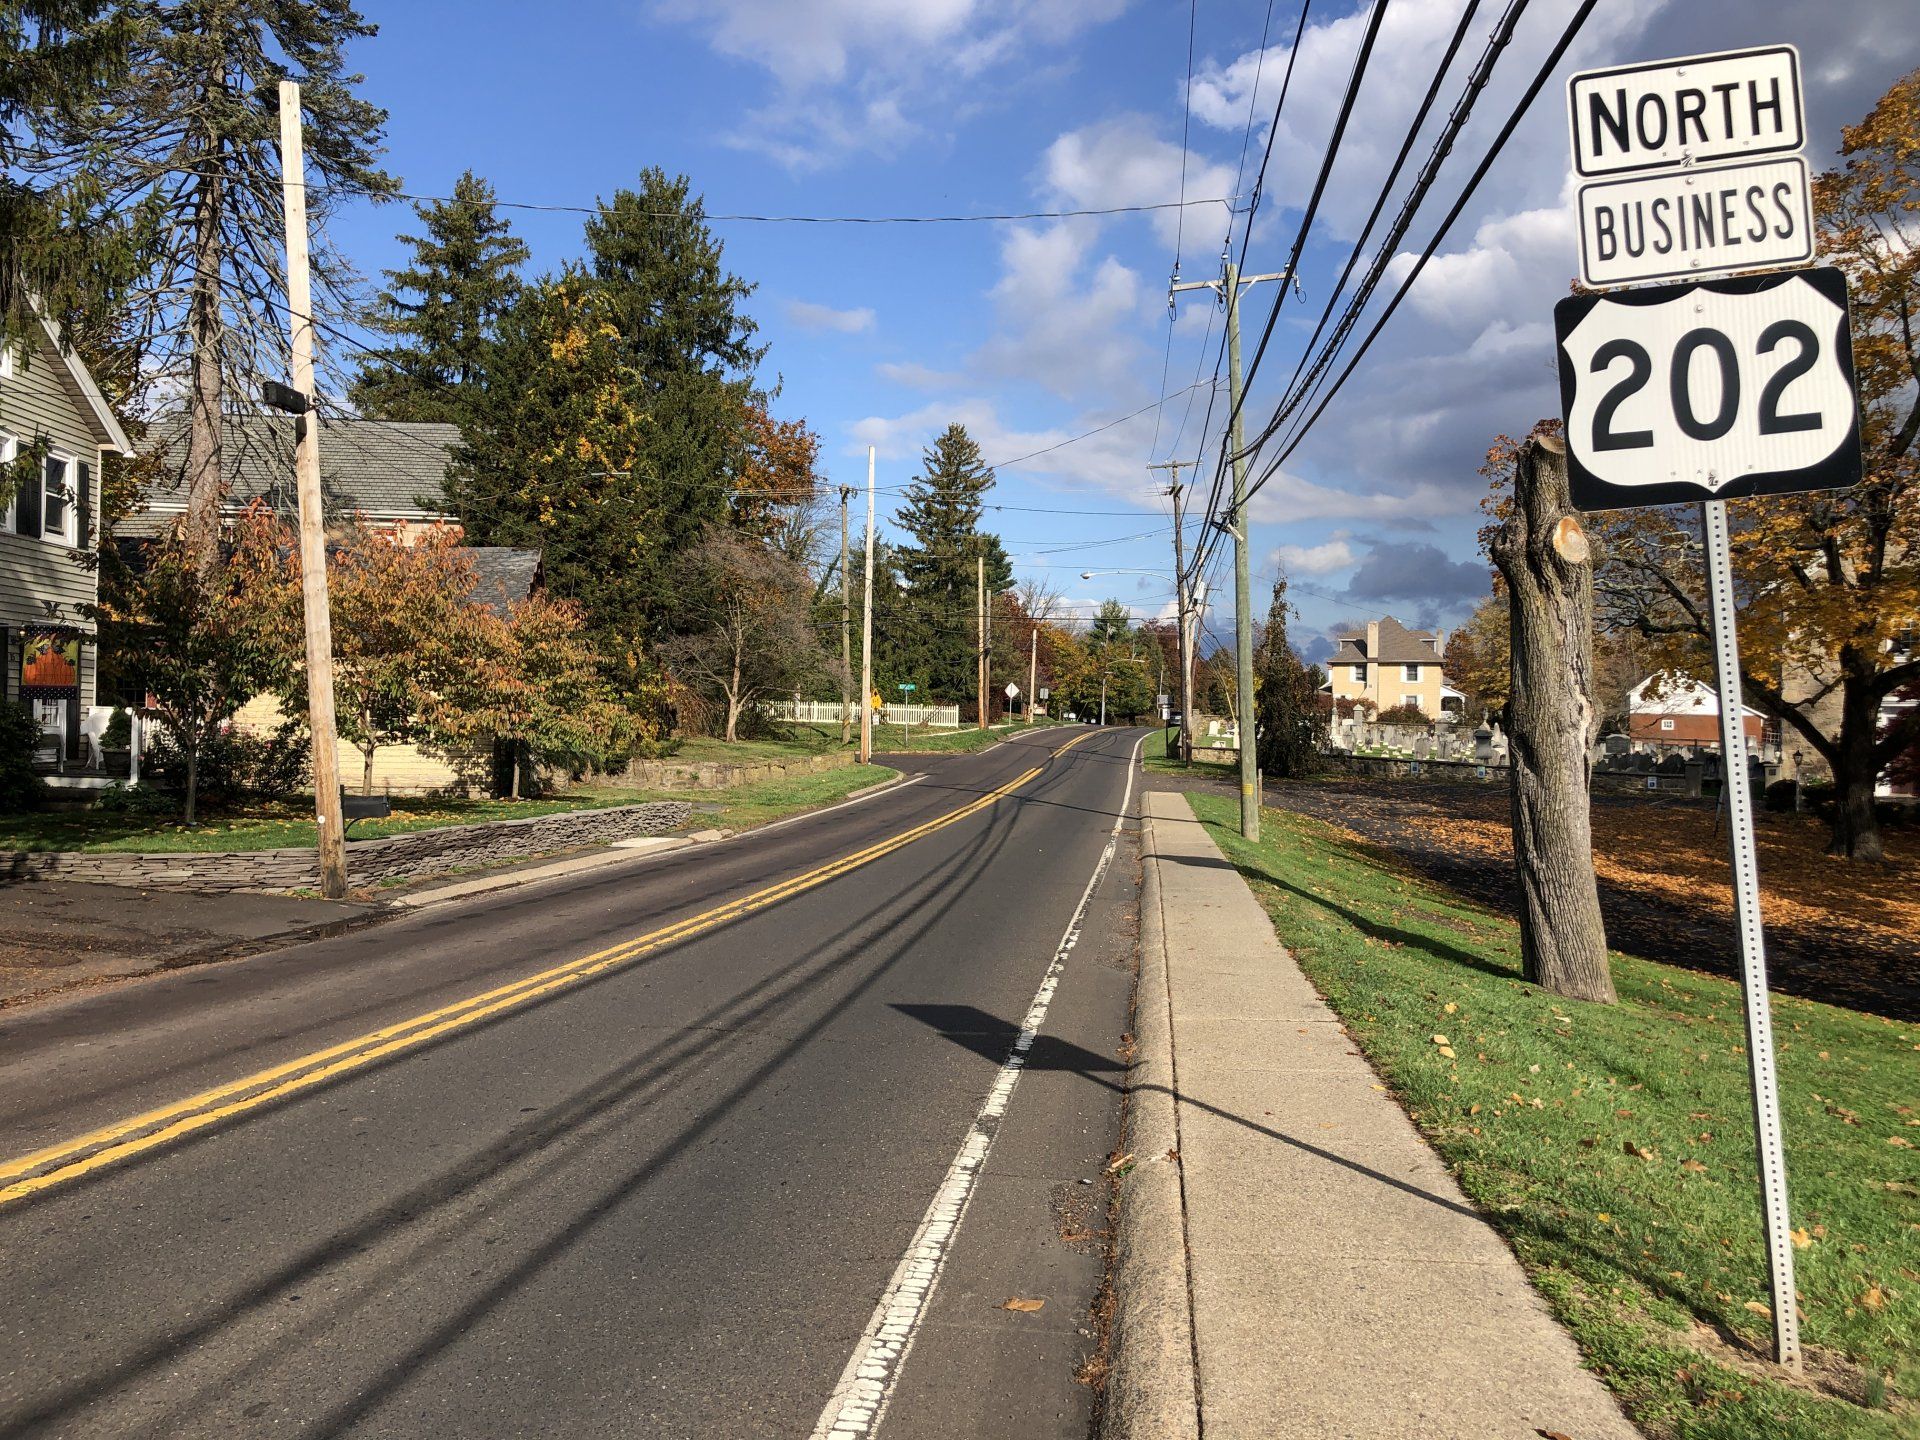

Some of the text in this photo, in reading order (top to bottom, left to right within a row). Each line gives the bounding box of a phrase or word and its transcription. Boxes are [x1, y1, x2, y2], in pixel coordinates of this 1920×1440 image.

[1588, 77, 1783, 157] NORTH
[1595, 182, 1794, 262] BUSINESS
[1590, 319, 1823, 453] 202
